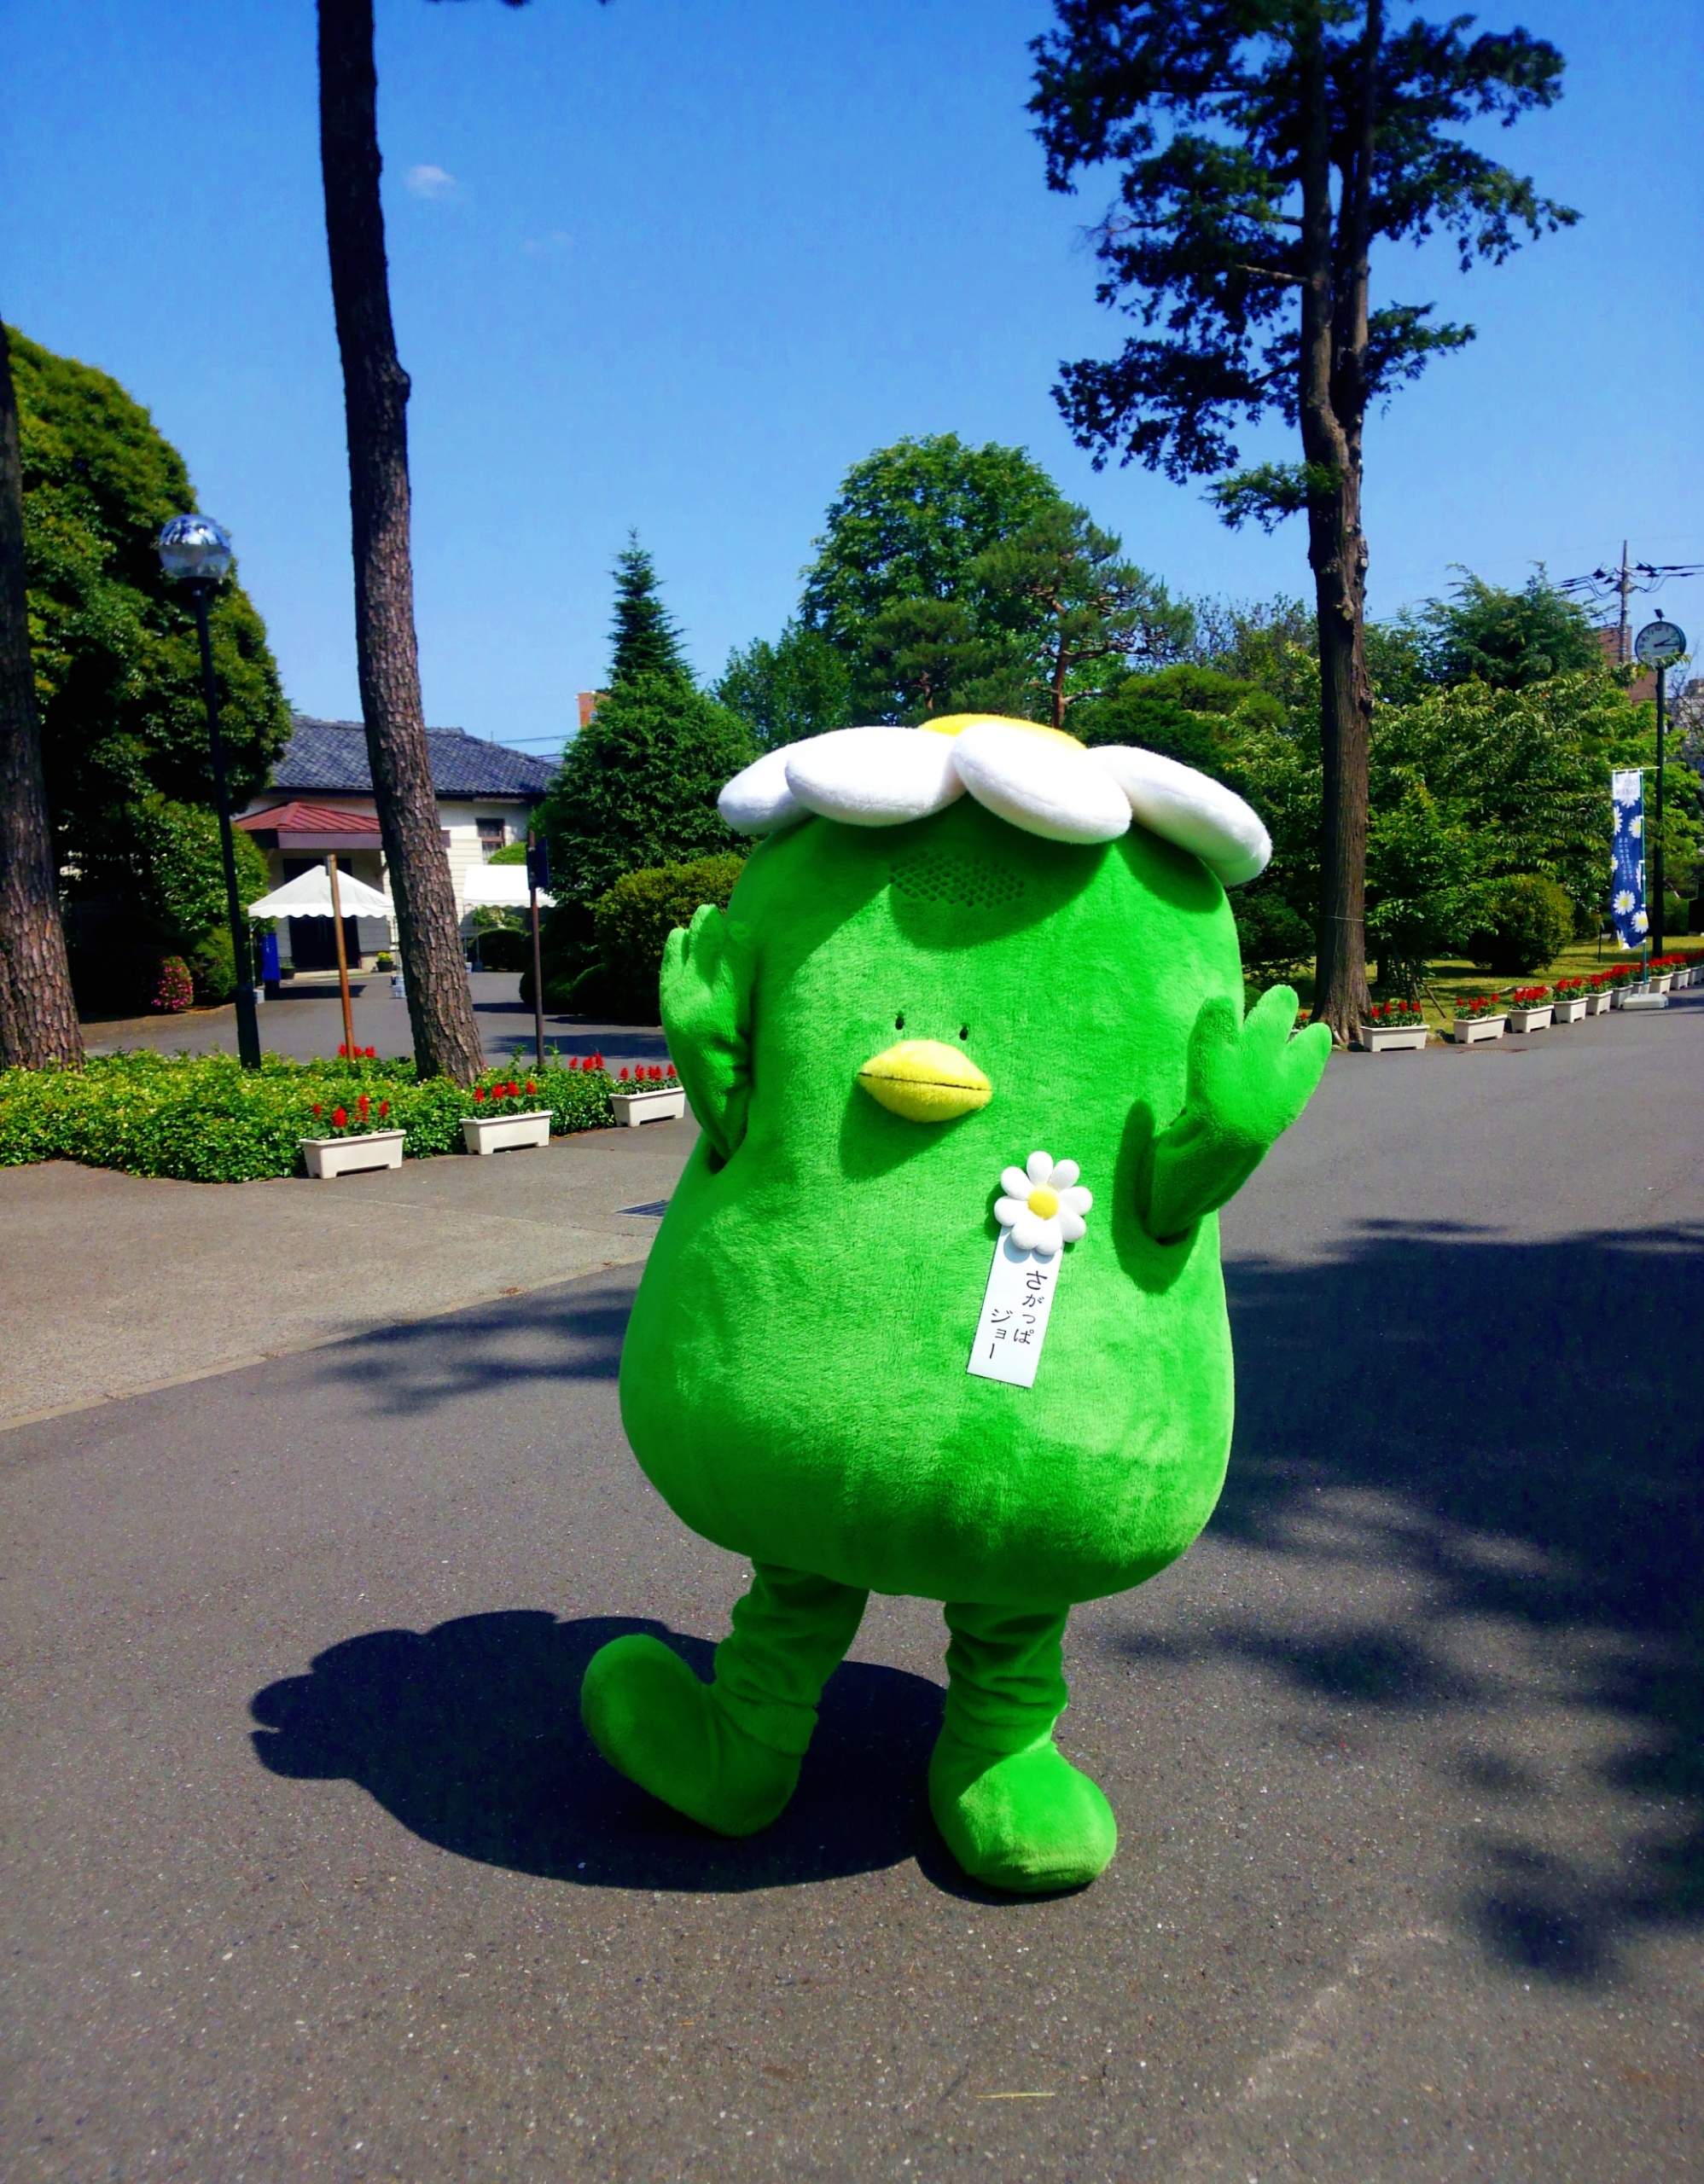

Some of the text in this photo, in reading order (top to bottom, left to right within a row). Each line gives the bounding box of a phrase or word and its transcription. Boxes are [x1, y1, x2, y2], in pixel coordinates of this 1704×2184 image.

[989, 1309, 1014, 1359] ジョー
[1013, 1269, 1049, 1345] さがっぱ
